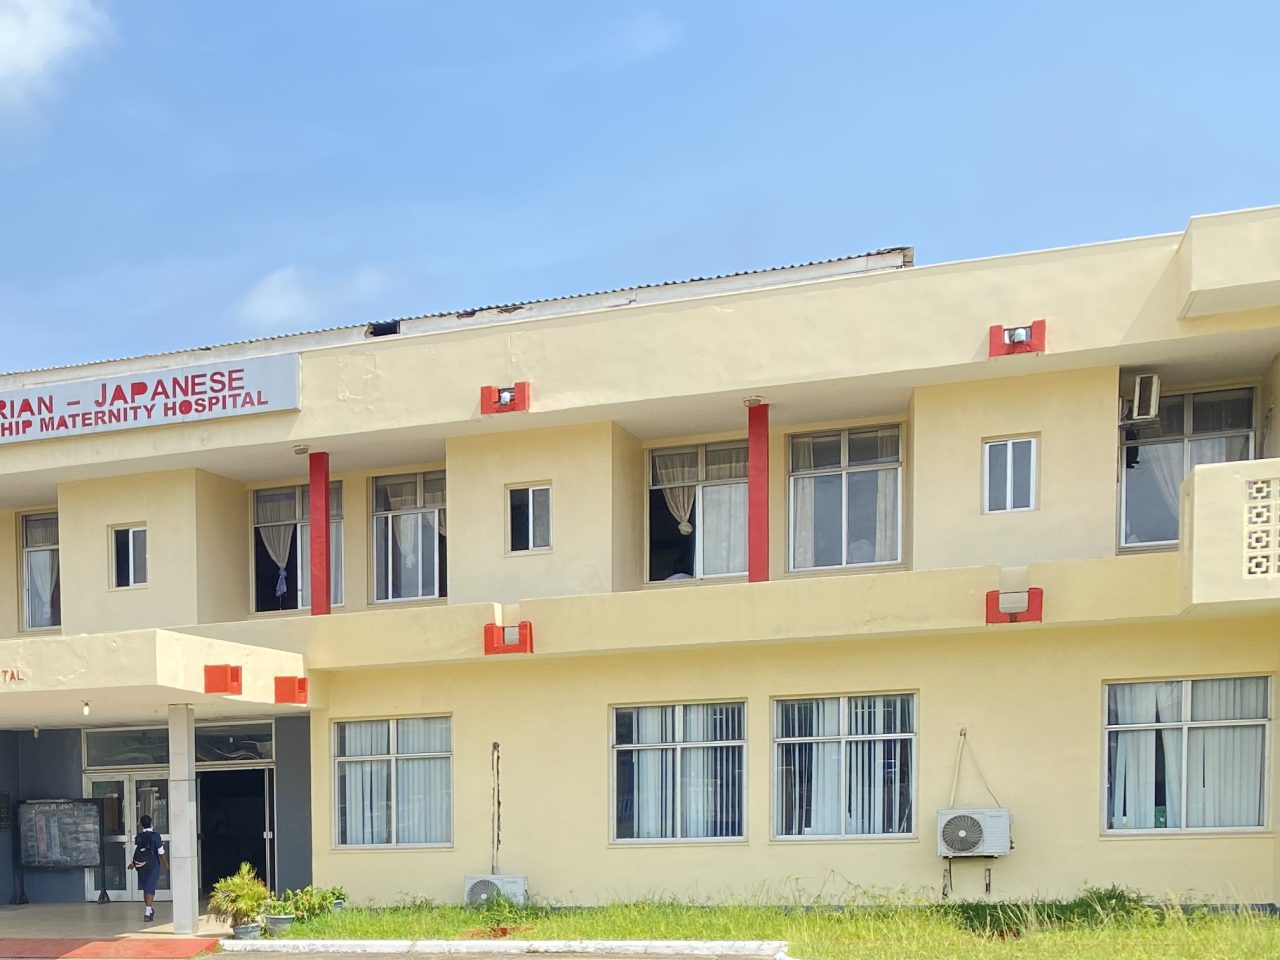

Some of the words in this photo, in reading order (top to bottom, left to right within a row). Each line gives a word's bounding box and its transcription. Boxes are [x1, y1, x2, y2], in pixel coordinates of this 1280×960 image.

[95, 369, 245, 408] JAPANESE
[40, 405, 153, 432] MATERNITY
[163, 391, 269, 416] HOSPITAL
